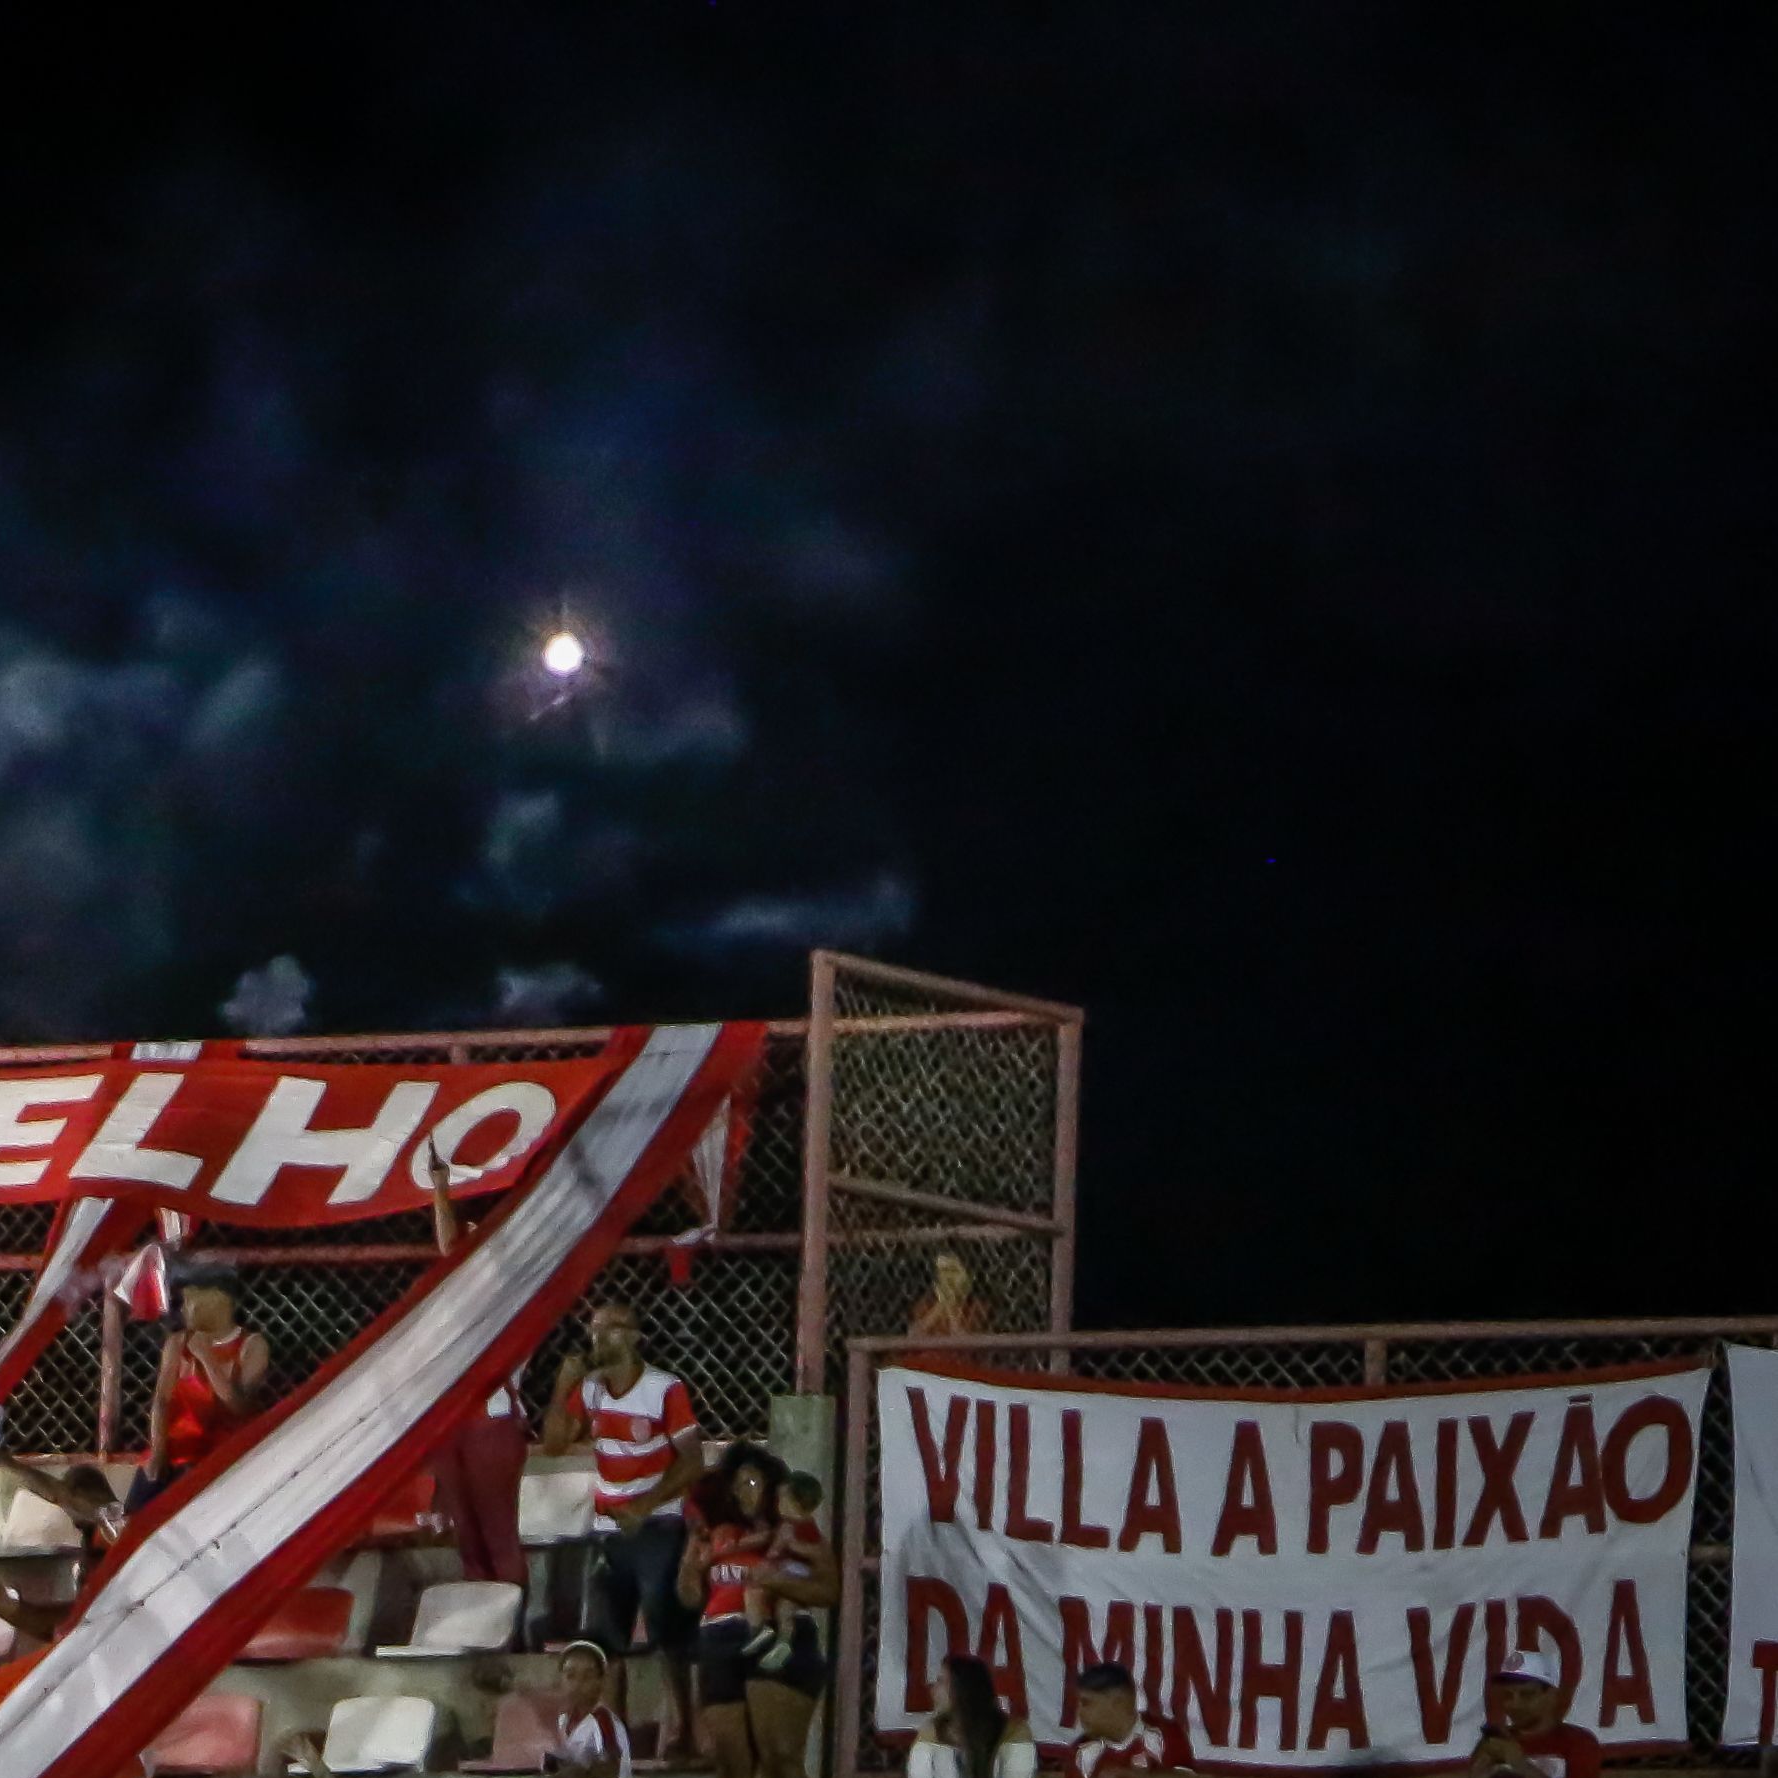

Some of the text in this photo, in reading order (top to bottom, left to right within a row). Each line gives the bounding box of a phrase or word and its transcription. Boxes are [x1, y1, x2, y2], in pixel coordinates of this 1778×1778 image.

[907, 1387, 1693, 1557] VILLA A PAIXÃO
[903, 1575, 1657, 1751] DA MINHA VIDA
